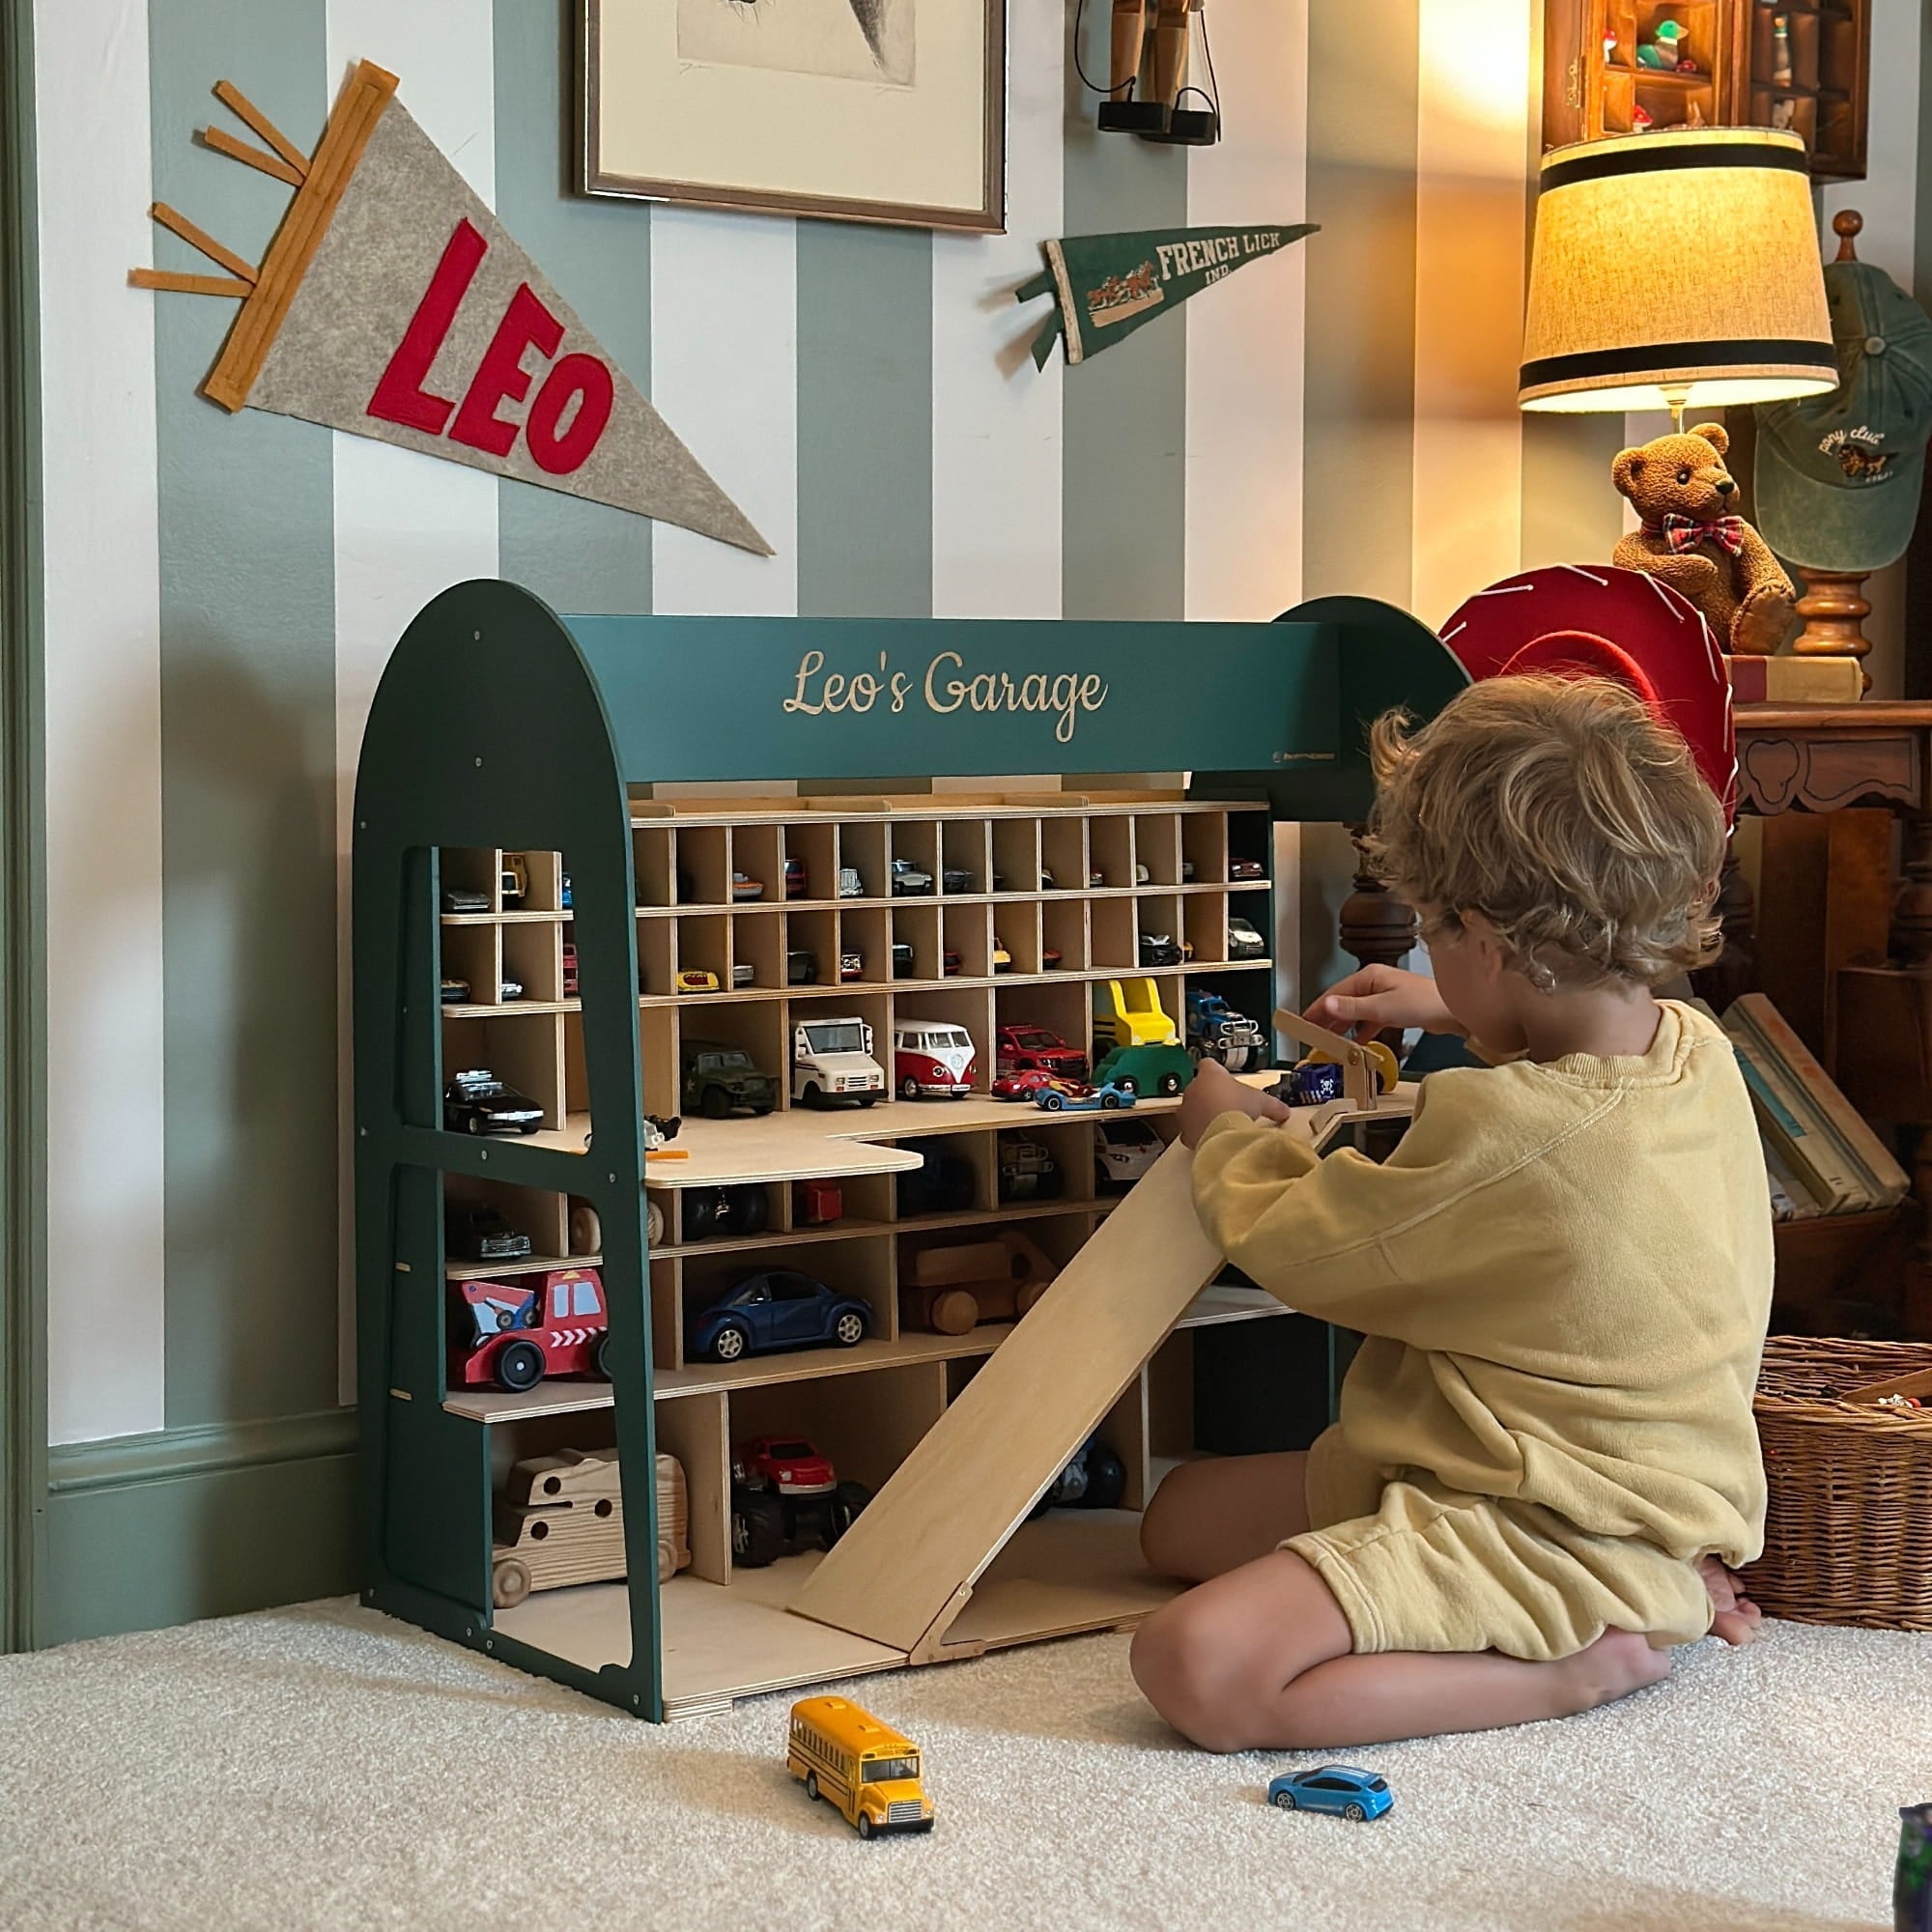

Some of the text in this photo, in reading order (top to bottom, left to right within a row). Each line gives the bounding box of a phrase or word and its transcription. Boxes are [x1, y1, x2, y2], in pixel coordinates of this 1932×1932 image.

[1155, 233, 1281, 281] FRENCH LICK
[367, 216, 614, 475] LEO
[1818, 429, 1848, 456] pony
[782, 650, 1109, 743] Leo's Garage
